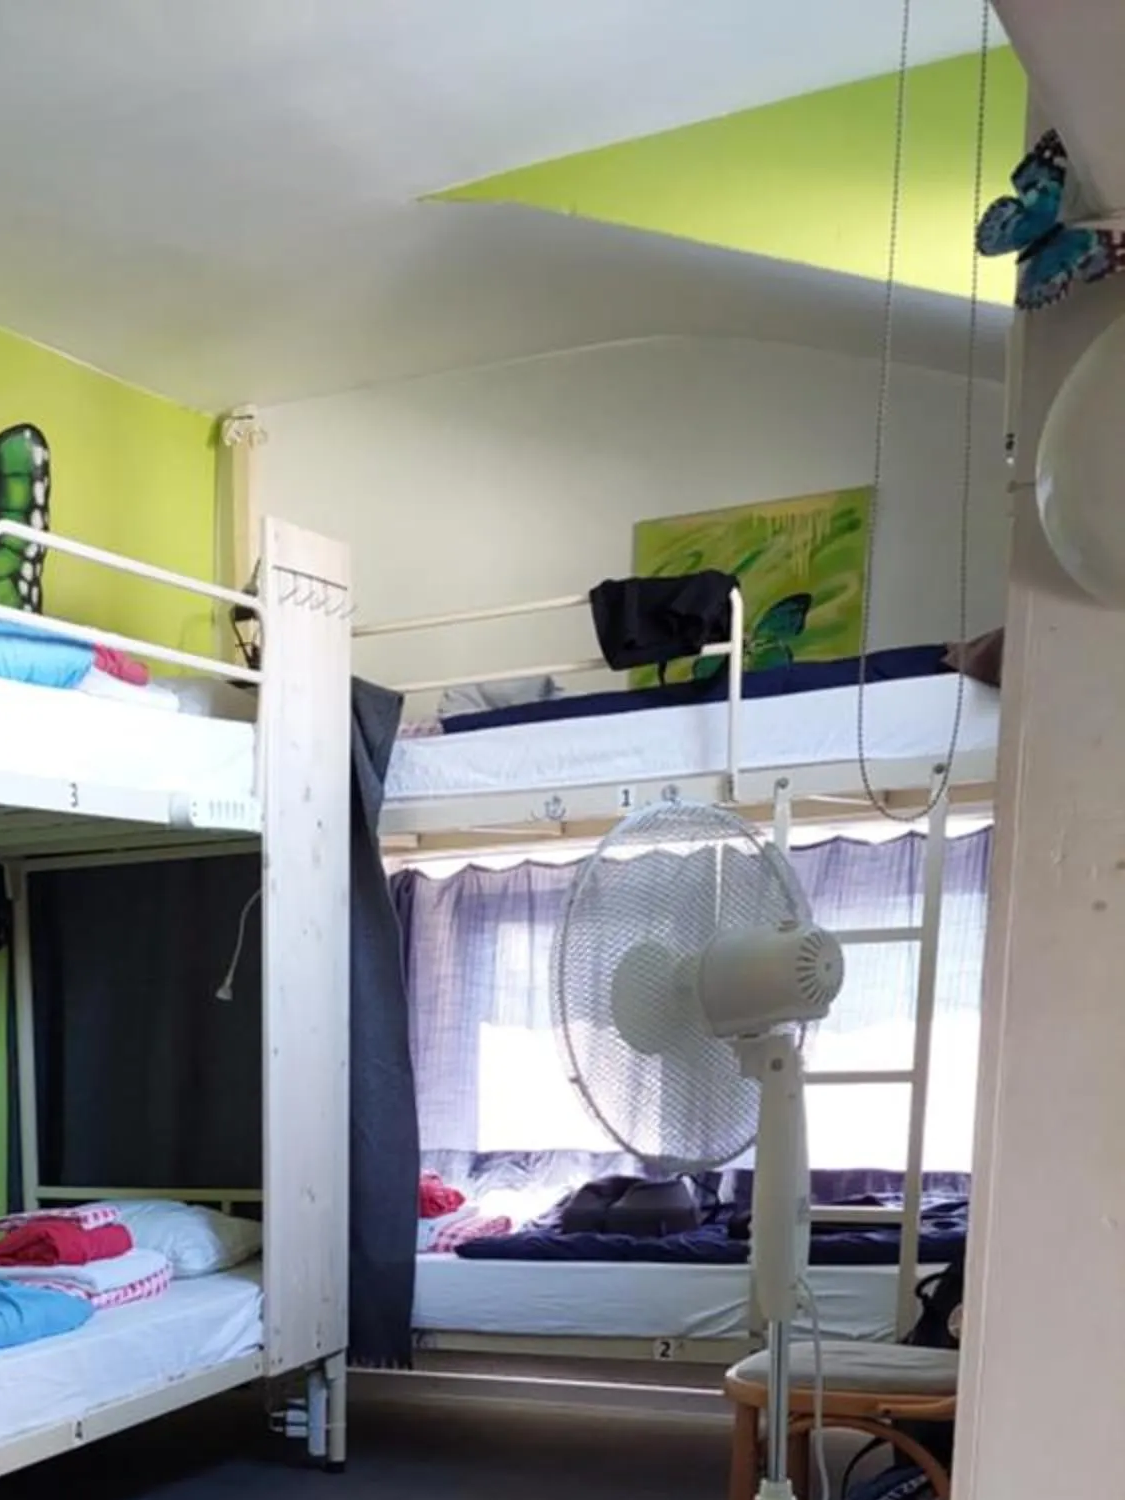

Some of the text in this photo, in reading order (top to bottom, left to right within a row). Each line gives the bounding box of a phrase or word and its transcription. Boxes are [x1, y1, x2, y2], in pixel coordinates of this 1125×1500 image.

[68, 782, 79, 808] 3
[621, 788, 631, 808] 1
[659, 1340, 672, 1359] 2
